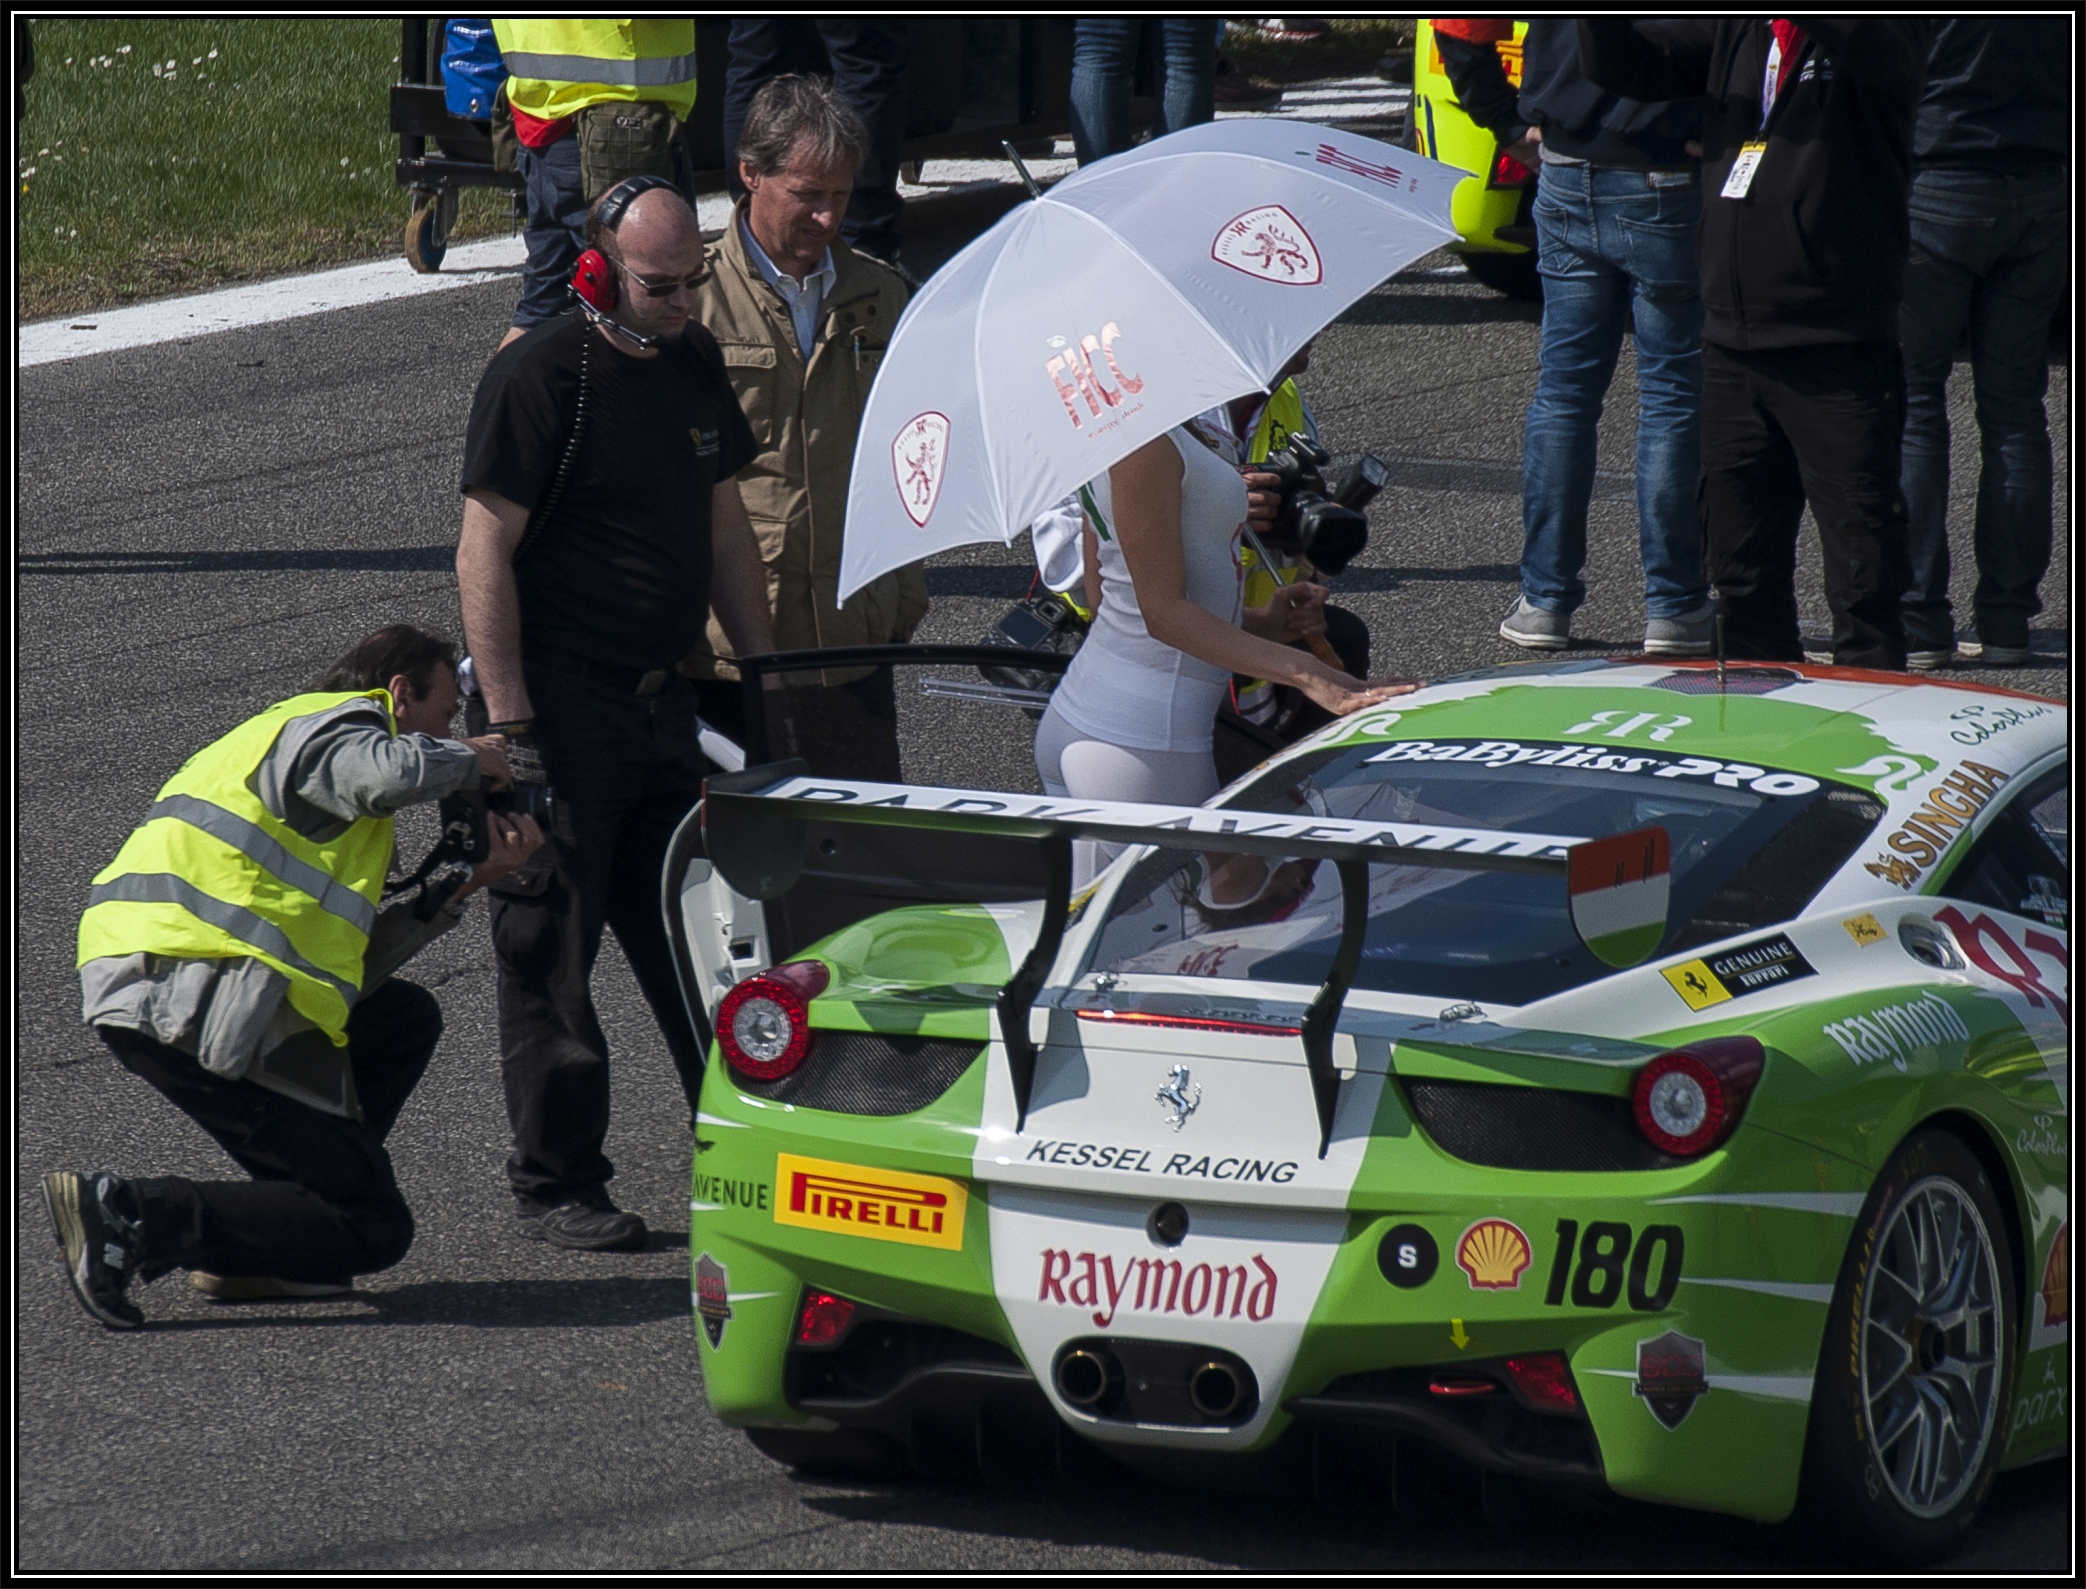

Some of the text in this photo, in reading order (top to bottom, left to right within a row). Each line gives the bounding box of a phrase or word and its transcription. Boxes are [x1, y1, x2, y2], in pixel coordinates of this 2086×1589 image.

[1887, 759, 2010, 869] SINGHA
[1713, 941, 1794, 976] GENUINE
[1822, 988, 1970, 1074] Raymond
[1026, 1139, 1299, 1184] KESSEL RACING
[788, 1171, 948, 1236] PIRELLI
[1038, 1247, 1278, 1329] Raymond
[1398, 1244, 1418, 1268] S
[1543, 1217, 1685, 1312] 180
[1642, 1354, 1701, 1379] SCC
